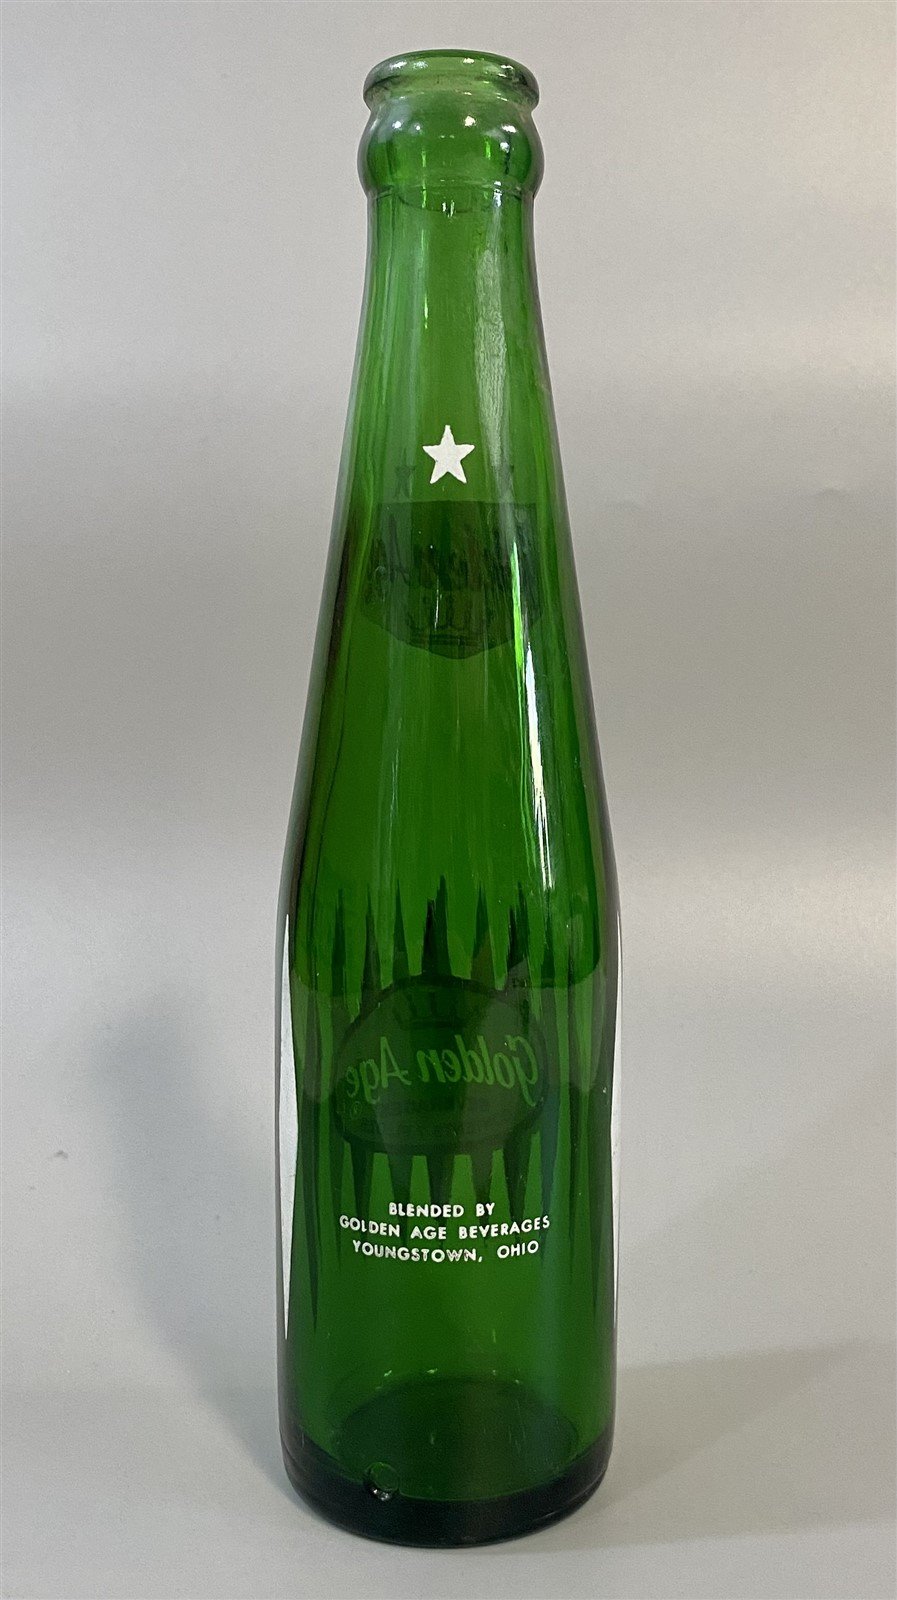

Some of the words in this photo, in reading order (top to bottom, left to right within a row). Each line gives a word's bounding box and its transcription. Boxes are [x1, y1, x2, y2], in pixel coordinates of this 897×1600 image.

[388, 1202, 465, 1218] BLENDED
[475, 1202, 496, 1217] BY
[339, 1214, 401, 1238] GOLDEN
[410, 1225, 447, 1240] AGE
[458, 1214, 551, 1240] BEVERAGES
[352, 1239, 483, 1263] YOUNGSTOWN,
[496, 1240, 539, 1259] OHIO
